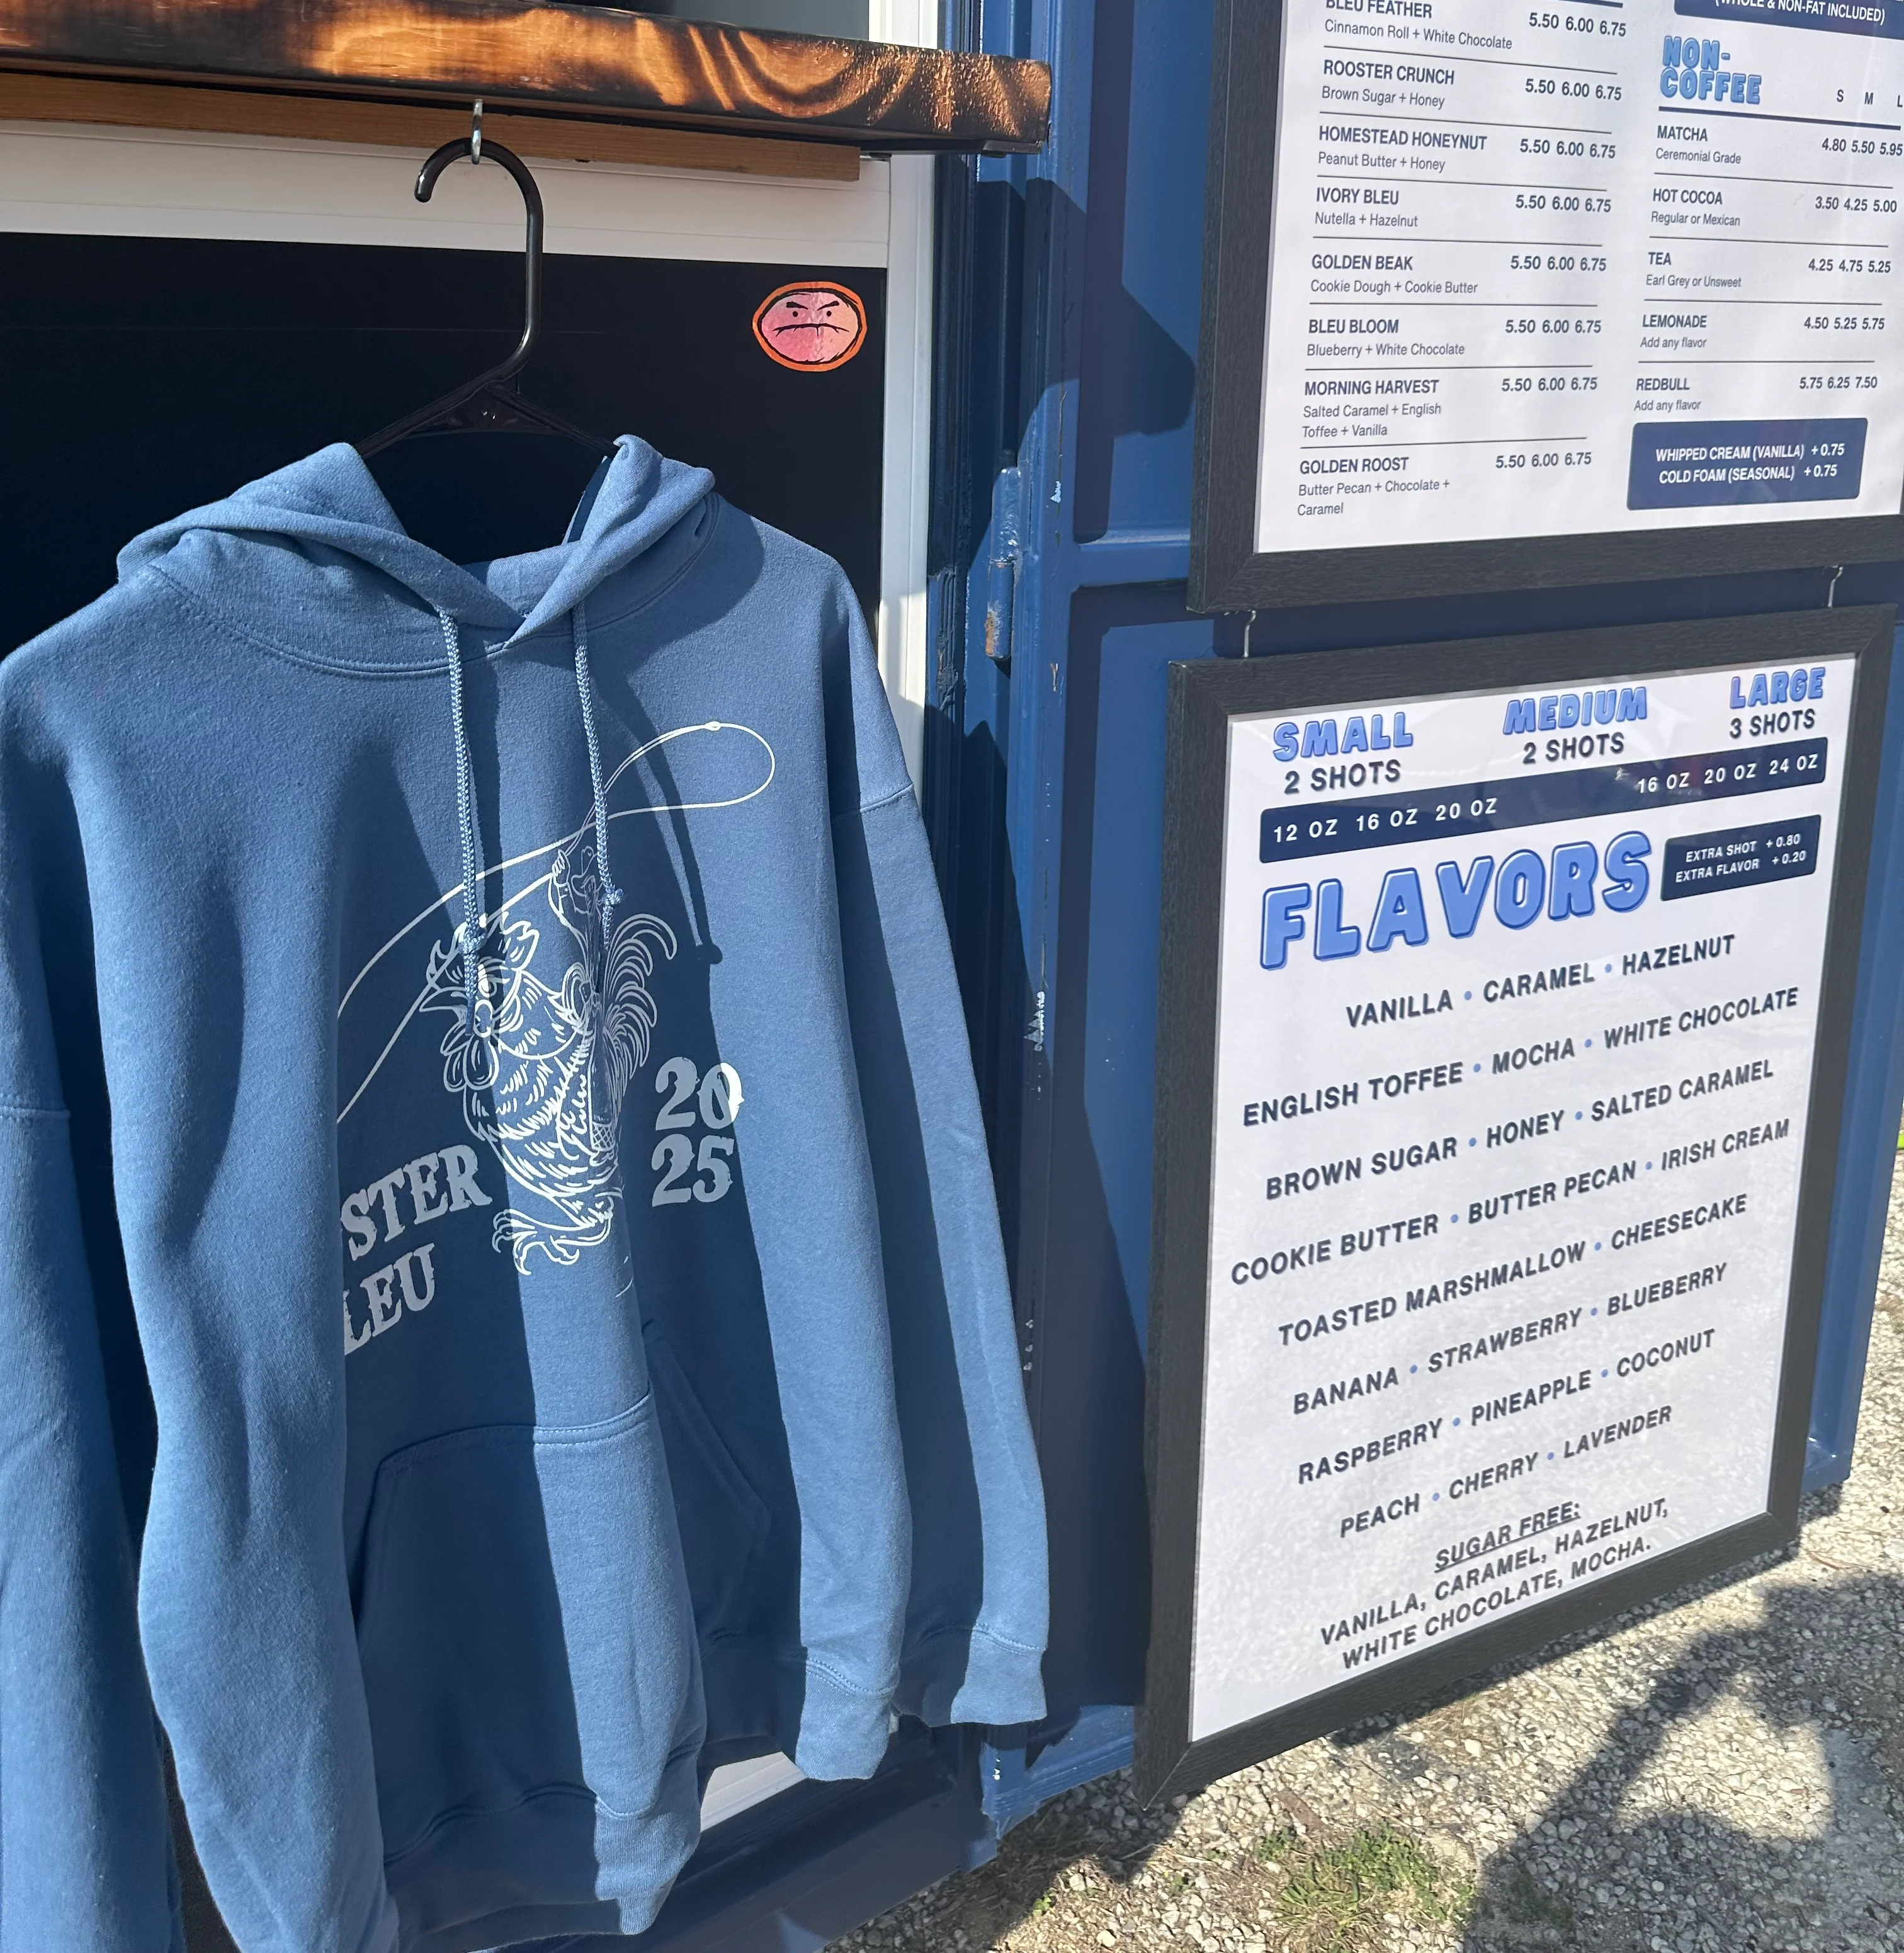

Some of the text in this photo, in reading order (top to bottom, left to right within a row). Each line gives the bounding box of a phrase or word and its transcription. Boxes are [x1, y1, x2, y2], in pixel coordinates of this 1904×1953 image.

[1368, 0, 1432, 18] FEATHER
[1778, 0, 1884, 25] NON-FAT INCLUDED)
[1325, 19, 1512, 49] Cinnamon Roll + White Chocolate
[1529, 13, 1626, 37] 5.50 6.00 6.75
[1662, 35, 1730, 70] NON-
[1323, 59, 1454, 85] ROOSTER CRUNCH
[1660, 67, 1762, 105] COFFEE
[1837, 89, 1903, 108] S M L
[1319, 125, 1487, 150] HOMESTEAD HONEYNUT
[1657, 125, 1708, 142] MATCHA
[1822, 138, 1903, 156] 4.80 5.50 5.95
[1520, 139, 1616, 159] 5.50 6.00 6.75
[1656, 147, 1741, 164] Ceremonial Grade
[1317, 187, 1399, 205] IVORY BLEU
[1653, 188, 1723, 205] HOT COCOA
[1315, 212, 1418, 227] Nutella + Hazelnut
[1651, 211, 1740, 226] Regular or Mexican
[1312, 254, 1413, 271] GOLDEN BEAK
[1648, 252, 1671, 265] TEA
[1808, 258, 1891, 273] 4.25 4.75 5.25
[1646, 274, 1742, 289] Earl Grey or Unsweet
[1309, 319, 1399, 334] BLEU BLOOM
[1643, 315, 1707, 328] LEMONADE
[1640, 337, 1707, 350] Add any flavor
[1305, 380, 1439, 395] MORNING HARVEST
[1502, 377, 1597, 392] 5.50 6.00 6.75
[1636, 378, 1690, 391] REDBULL
[1799, 376, 1878, 389] 5.75 6.25 7.50
[1300, 457, 1409, 475] GOLDEN ROOST
[1656, 443, 1845, 461] WHIPPED CREAM (VANILLA) + 0.75
[1659, 464, 1837, 484] COLD FOAM (SEASONAL) + 0.75
[1730, 667, 1826, 710] LARGE
[1502, 686, 1647, 735] MEDIUM
[1730, 708, 1815, 739] 3 SHOTS
[1272, 711, 1414, 762] SMALL
[1522, 732, 1624, 764] 2 SHOTS
[1284, 759, 1401, 795] 2 SHOTS
[1638, 754, 1818, 793] 16 OZ 20 OZ 24 OZ
[1274, 798, 1497, 842] 12 OZ 16 OZ 20 OZ
[1686, 847, 1723, 863] EXTRA
[1726, 841, 1757, 856] SHOT
[1776, 834, 1800, 847] 0.80
[1675, 866, 1713, 883] EXTRA
[1716, 858, 1759, 875] FLAVOR
[1782, 851, 1806, 864] 0.20
[1259, 830, 1652, 970] FLAVORS
[1346, 934, 1735, 1027] VANILLA CARAMEL HAZELNUT
[1244, 987, 1798, 1127] ENGLISH TOFFEE MOCHA WHITE CHOCOLATE
[655, 1056, 744, 1132] 20
[1266, 1059, 1773, 1200] BROWN SUGAR HONEY SALTED CARAMEL
[651, 1134, 735, 1208] 25
[341, 1145, 492, 1260] STER
[1232, 1118, 1789, 1285] COOKIE BUTTER BUTTER PECAN IRISH CREAM
[1278, 1194, 1747, 1345] TOASTED MARSHMALLOW CHEESECAKE
[343, 1243, 435, 1355] LEU
[1294, 1262, 1726, 1415] BANANA STRAWBERRY BLUEBERRY
[1298, 1328, 1715, 1485] RASPBERRY PINEAPPLE COCONUT
[1340, 1405, 1672, 1538] PEACH CHERRY LAVENDER
[1434, 1501, 1580, 1570] SUGAR FREE:
[1321, 1498, 1668, 1646] VANILLA, CARAMEL, HAZELNUT,
[1342, 1537, 1650, 1669] WHITE CHOCOLATE, MOCHA.
